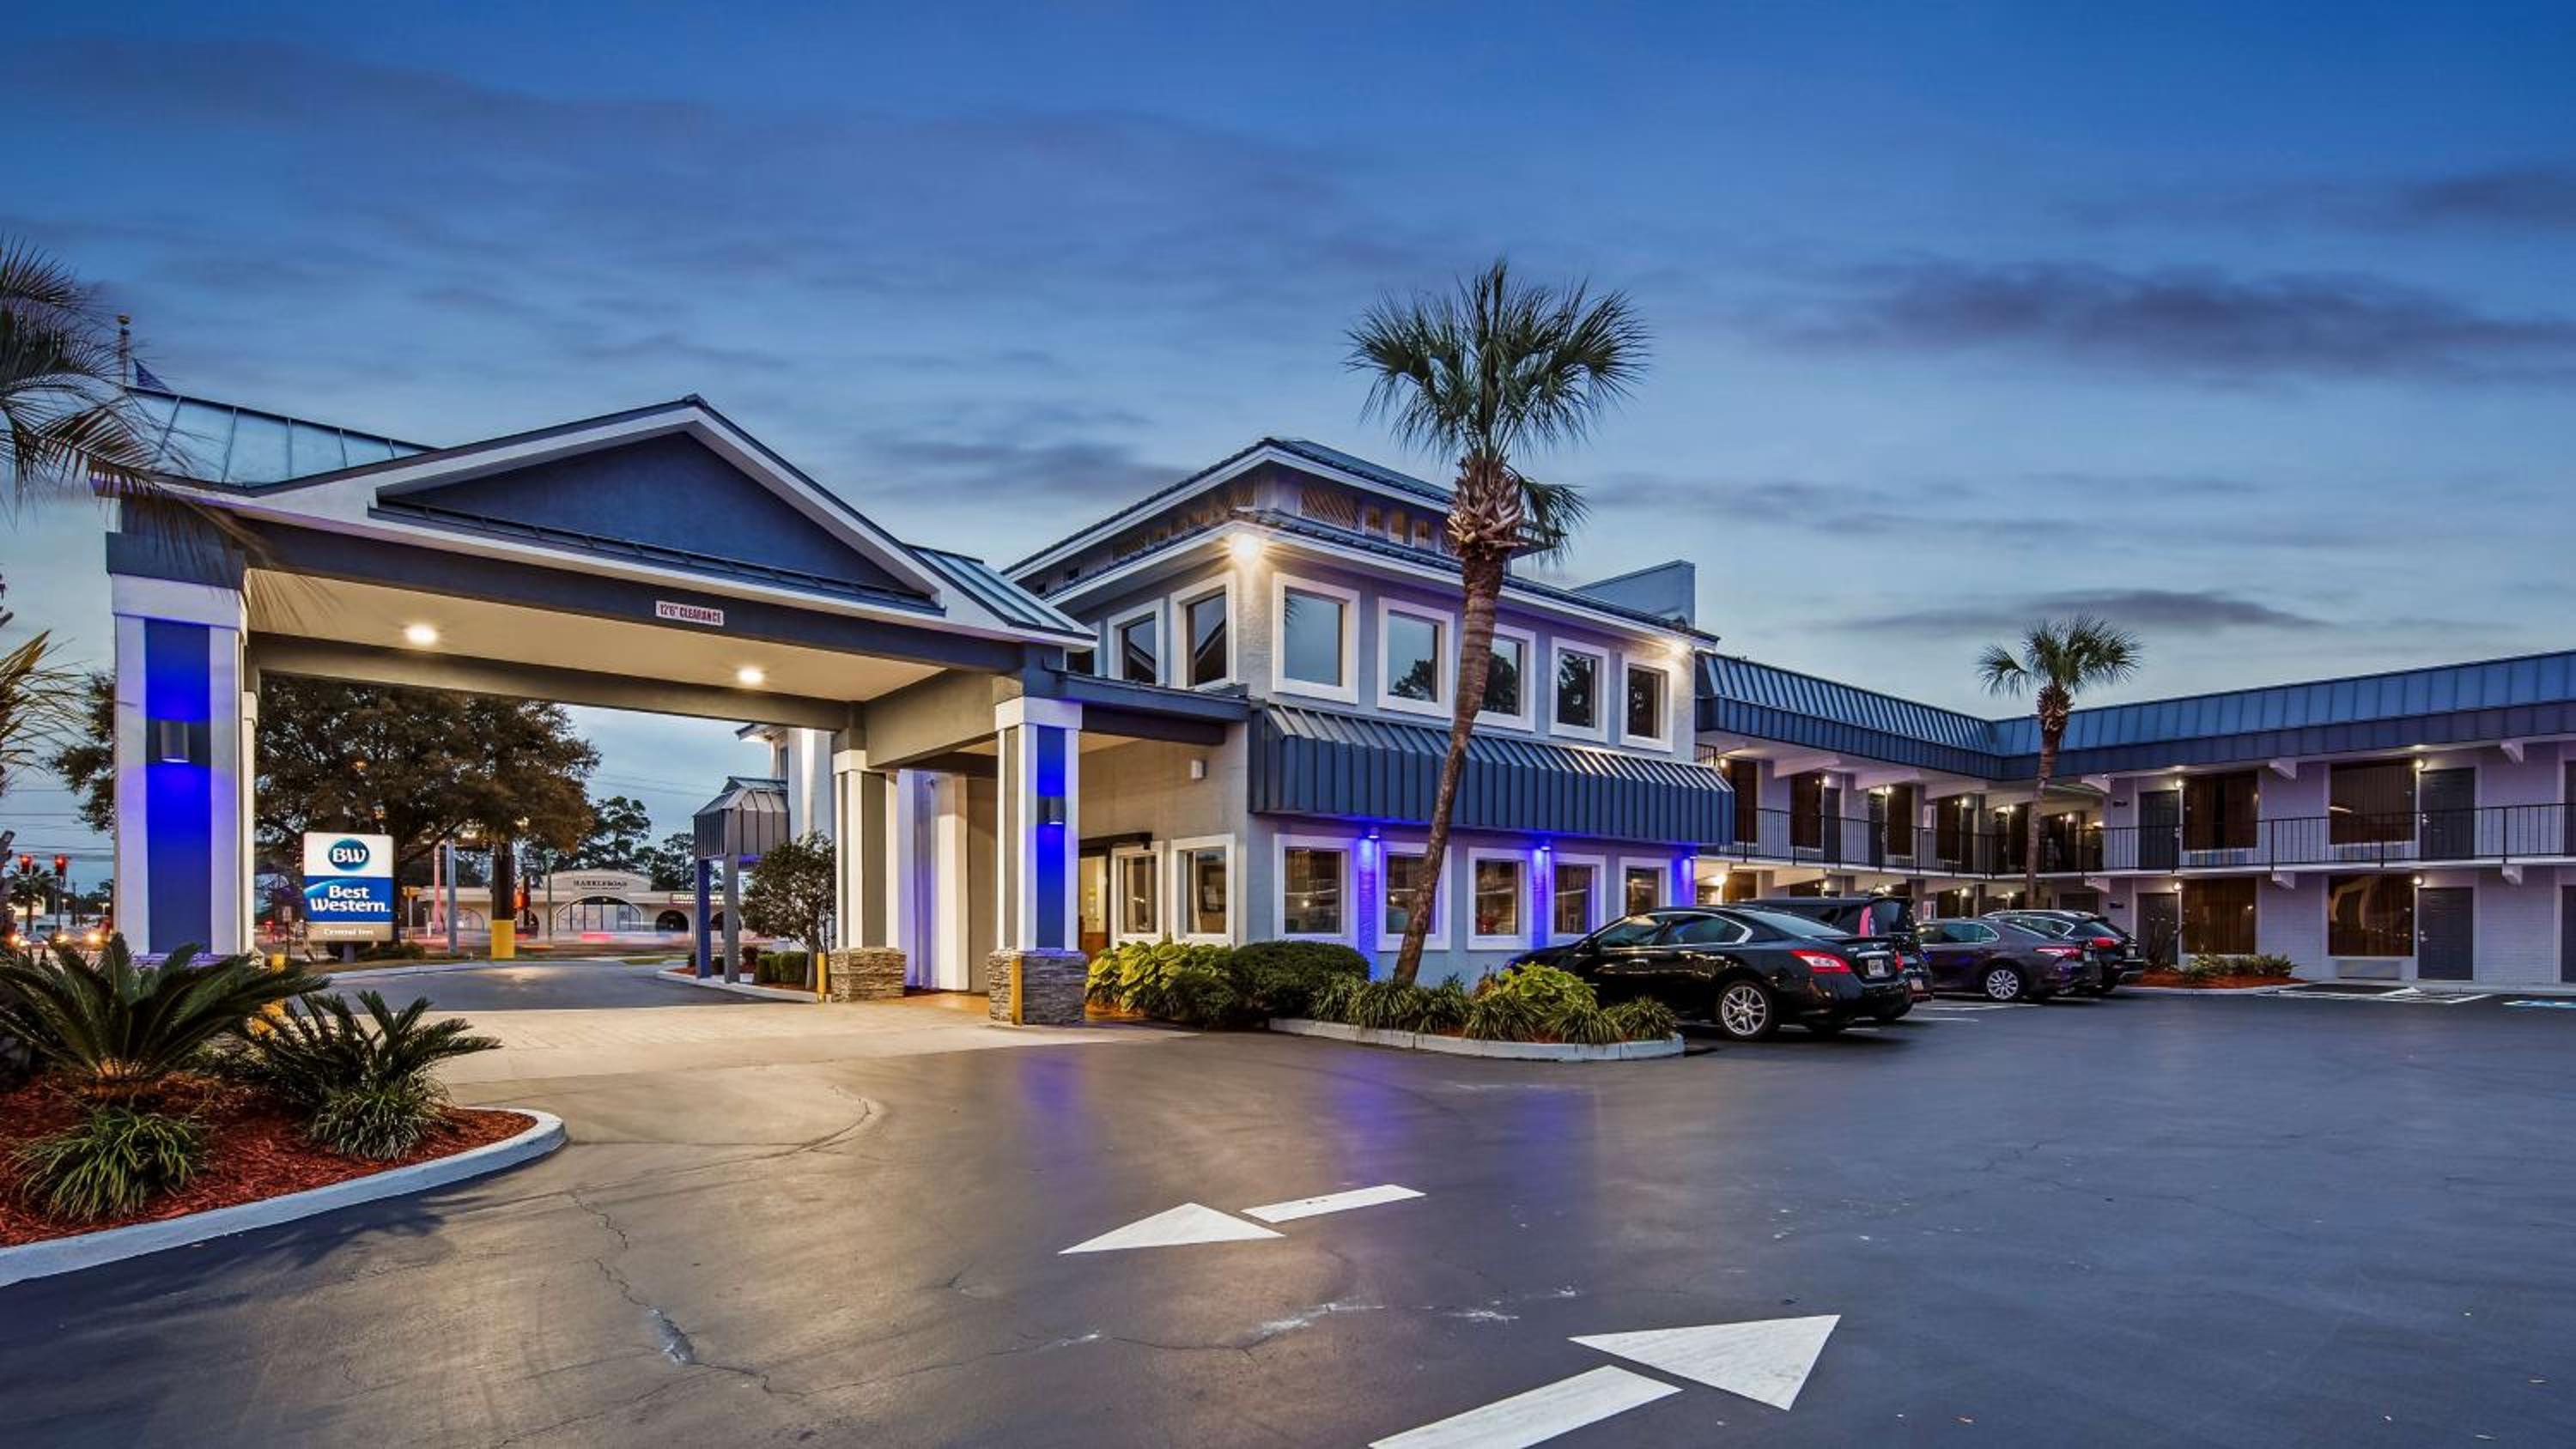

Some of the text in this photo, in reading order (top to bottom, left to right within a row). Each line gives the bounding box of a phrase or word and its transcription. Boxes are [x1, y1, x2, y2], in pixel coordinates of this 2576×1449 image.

[679, 607, 721, 623] CLEARANCE
[332, 847, 367, 863] BW
[329, 885, 370, 899] Best
[310, 898, 386, 912] Western
